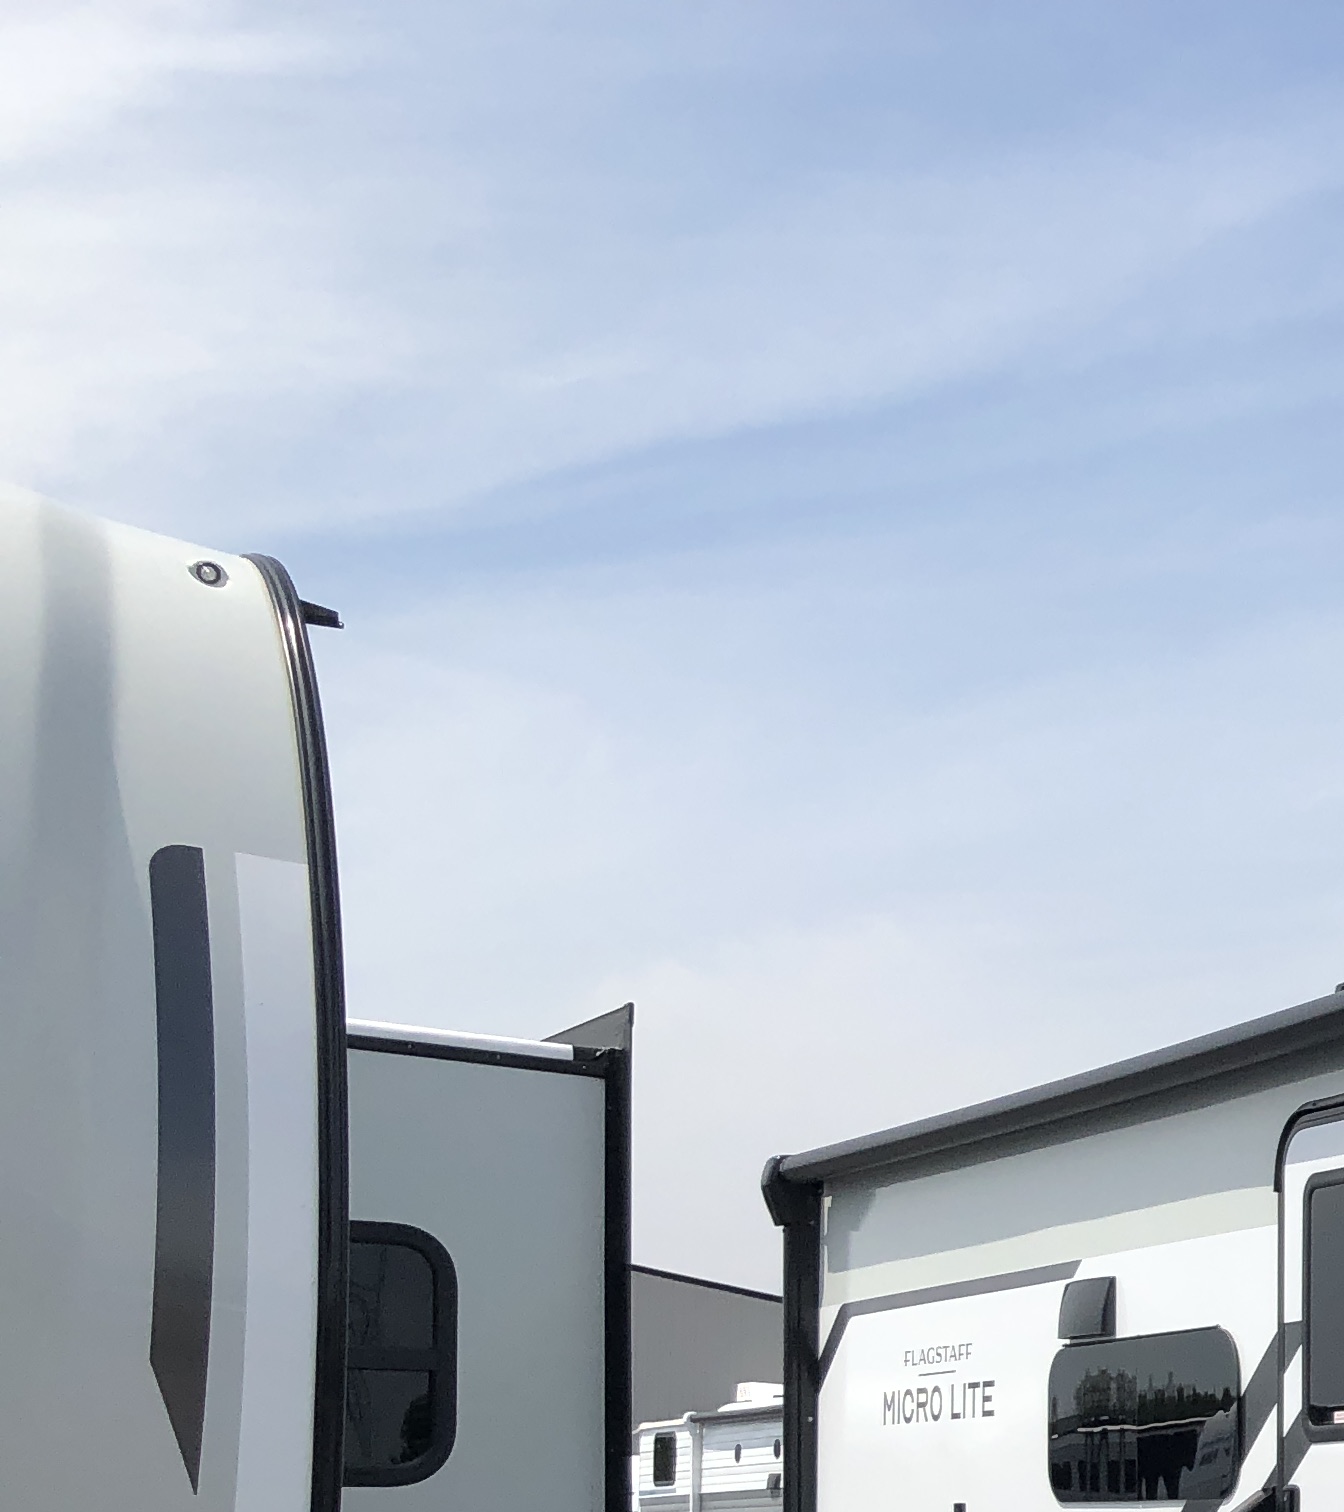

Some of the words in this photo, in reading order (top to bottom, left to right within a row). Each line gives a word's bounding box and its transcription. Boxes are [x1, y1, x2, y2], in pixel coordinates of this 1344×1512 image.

[904, 1343, 972, 1366] FLAGSTAFF
[883, 1385, 942, 1425] MICRO
[950, 1380, 995, 1419] LITE
